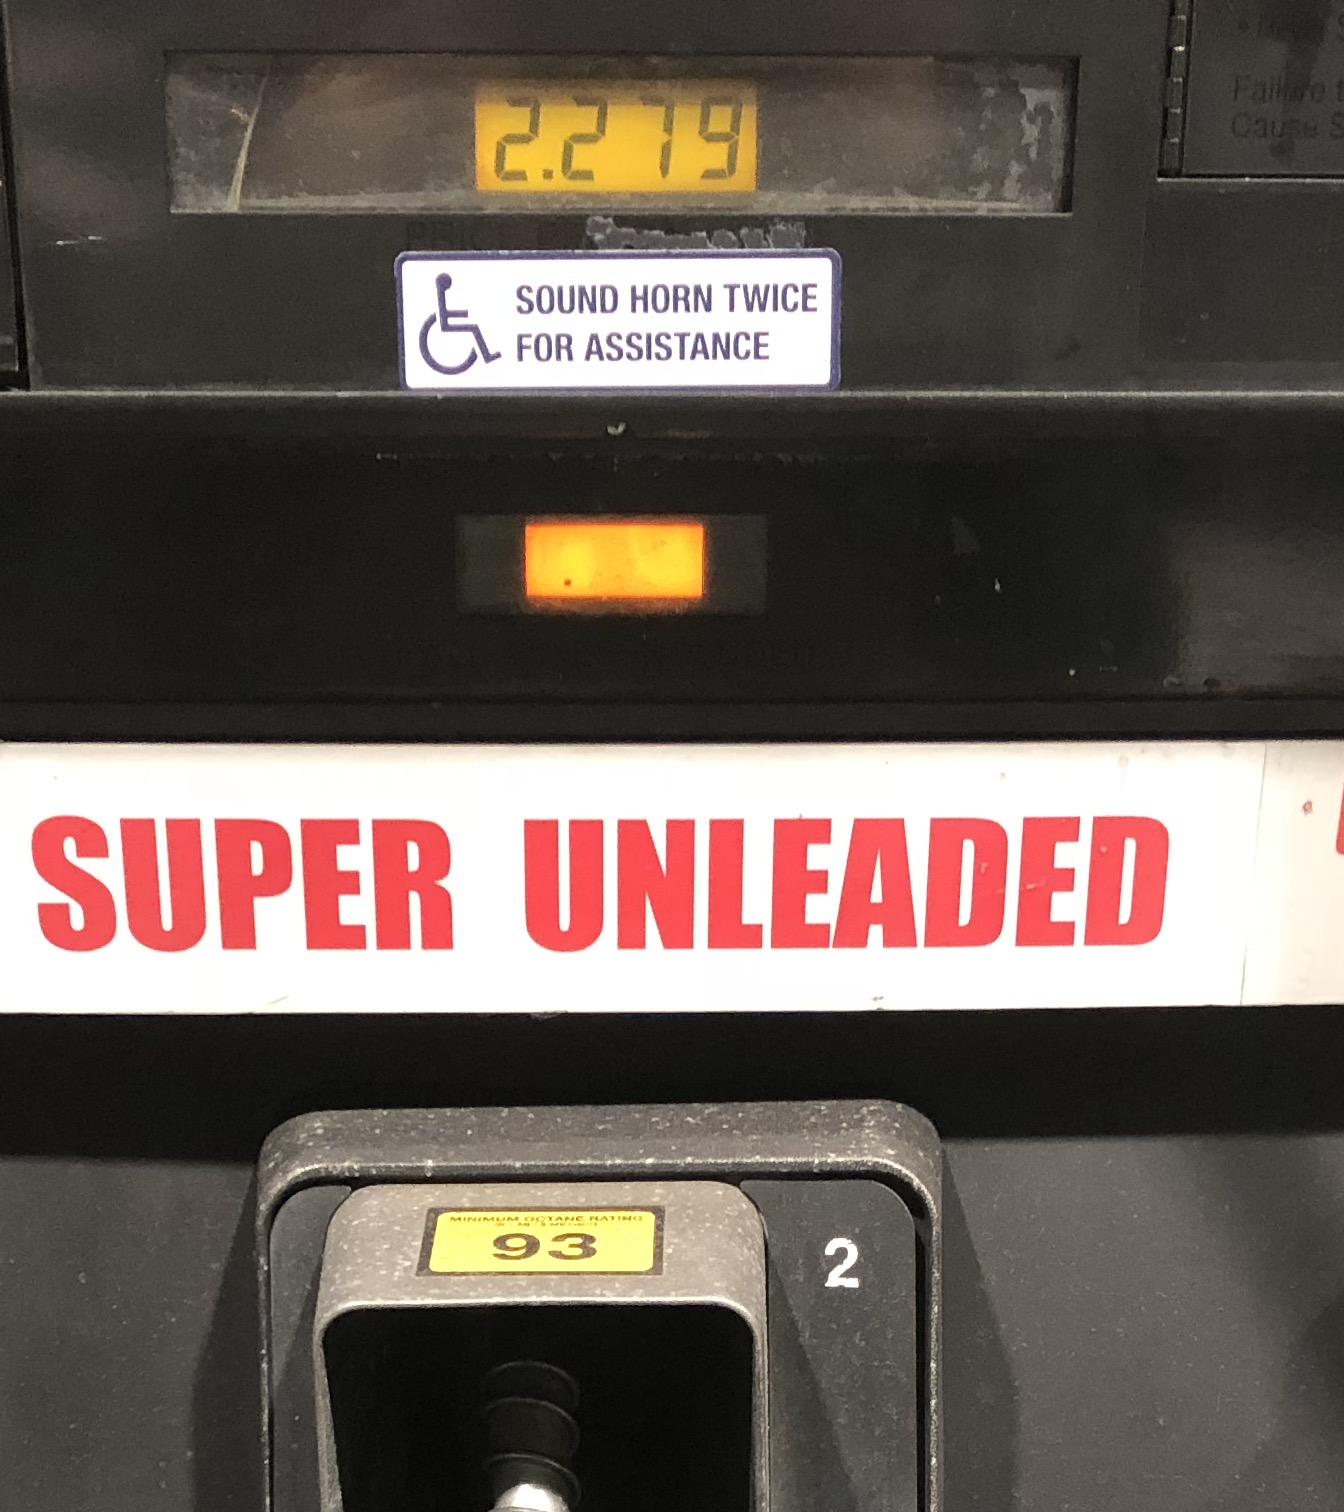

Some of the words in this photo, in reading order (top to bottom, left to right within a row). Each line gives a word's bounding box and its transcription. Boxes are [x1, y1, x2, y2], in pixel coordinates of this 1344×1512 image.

[494, 96, 741, 183] 2.279
[516, 284, 619, 314] SOUND
[630, 283, 713, 314] HORN
[723, 283, 818, 312] TWICE
[516, 333, 573, 362] FOR
[584, 331, 770, 362] ASSISTANCE
[31, 815, 454, 952] SUPER
[523, 815, 1172, 952] UNLEADED
[492, 1233, 598, 1261] 93
[824, 1237, 860, 1288] 2
